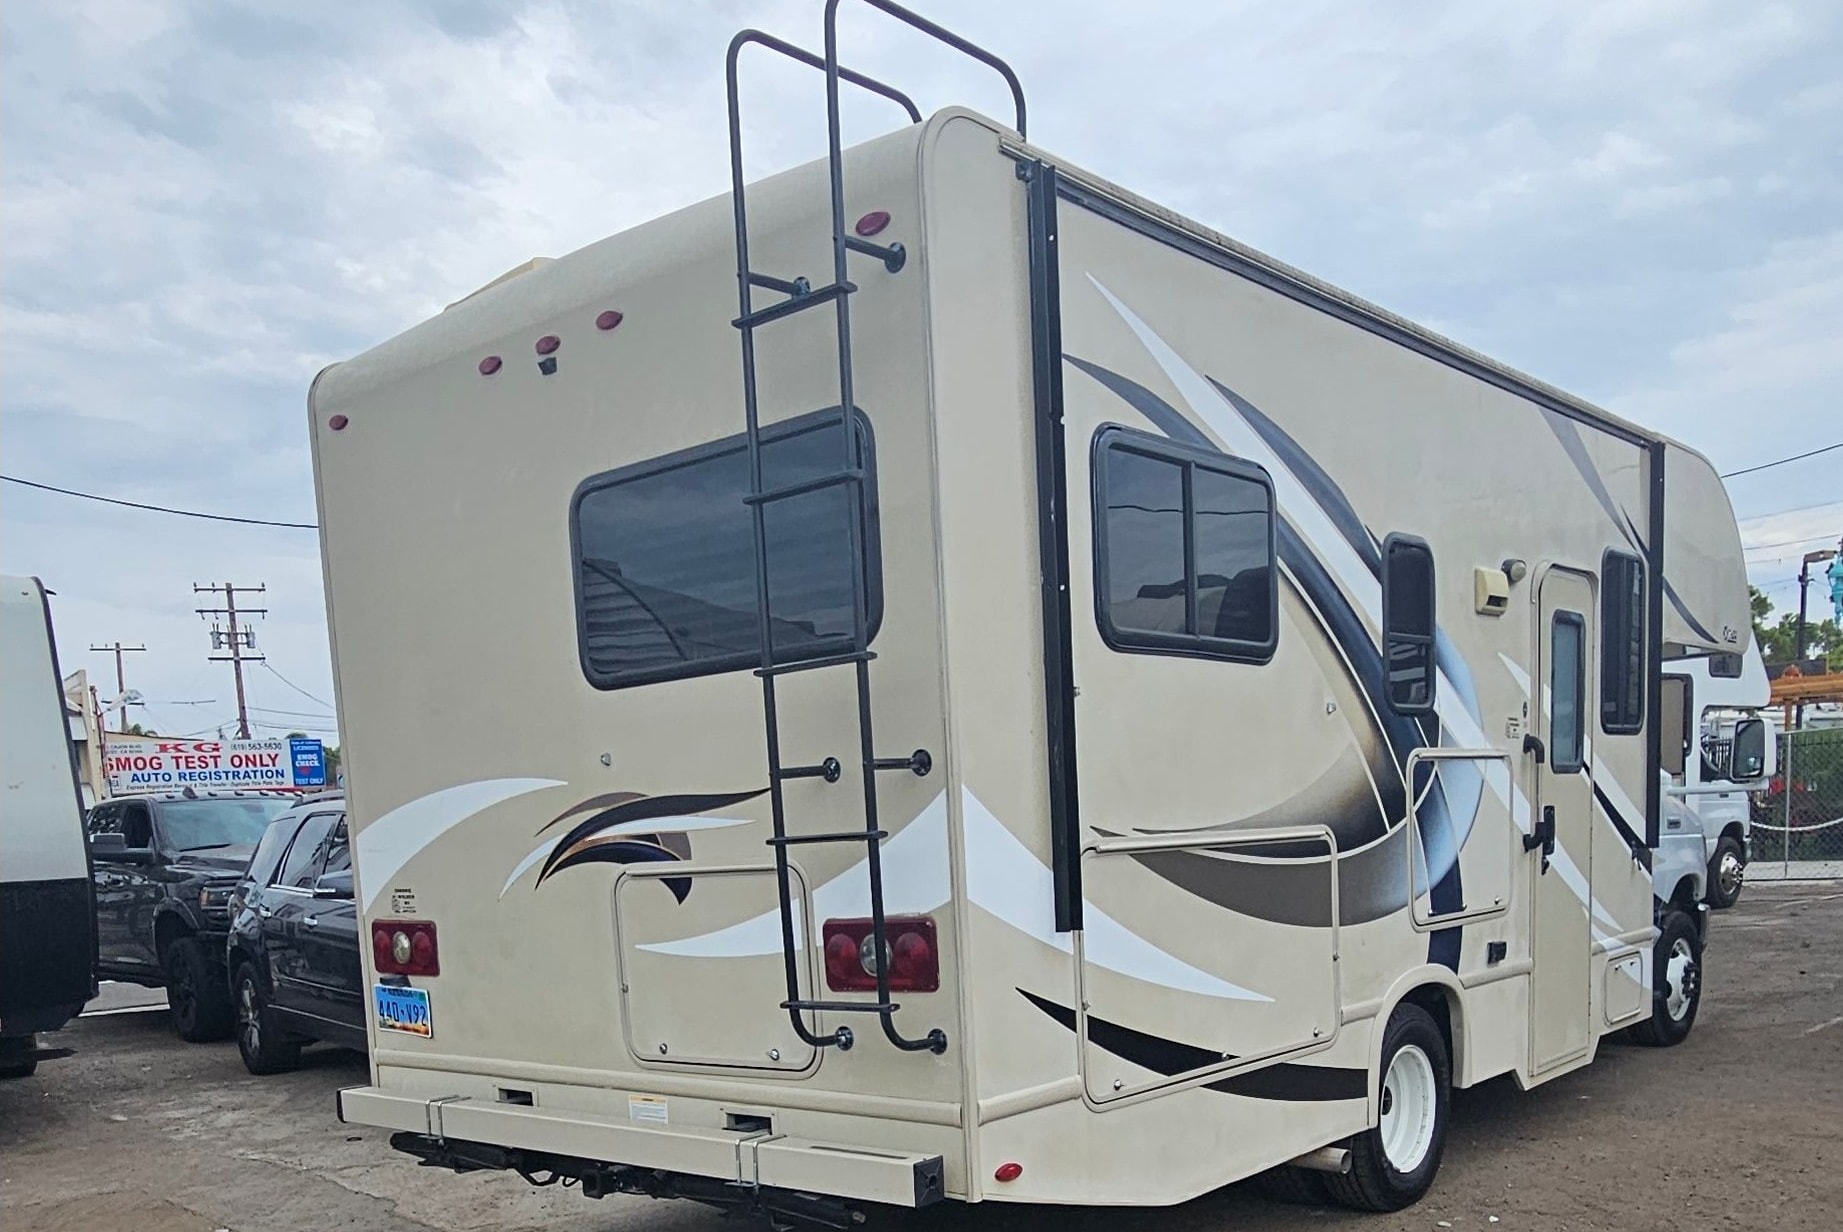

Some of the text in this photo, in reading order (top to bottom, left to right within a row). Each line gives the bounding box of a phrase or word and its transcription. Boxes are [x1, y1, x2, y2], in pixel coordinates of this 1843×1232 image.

[154, 742, 223, 753] KG
[170, 754, 221, 770] TEST
[230, 753, 279, 769] ONLY
[297, 753, 318, 761] SMOG
[131, 772, 172, 783] AUTO
[178, 769, 285, 782] REGISTRATION
[309, 777, 324, 785] ONLY
